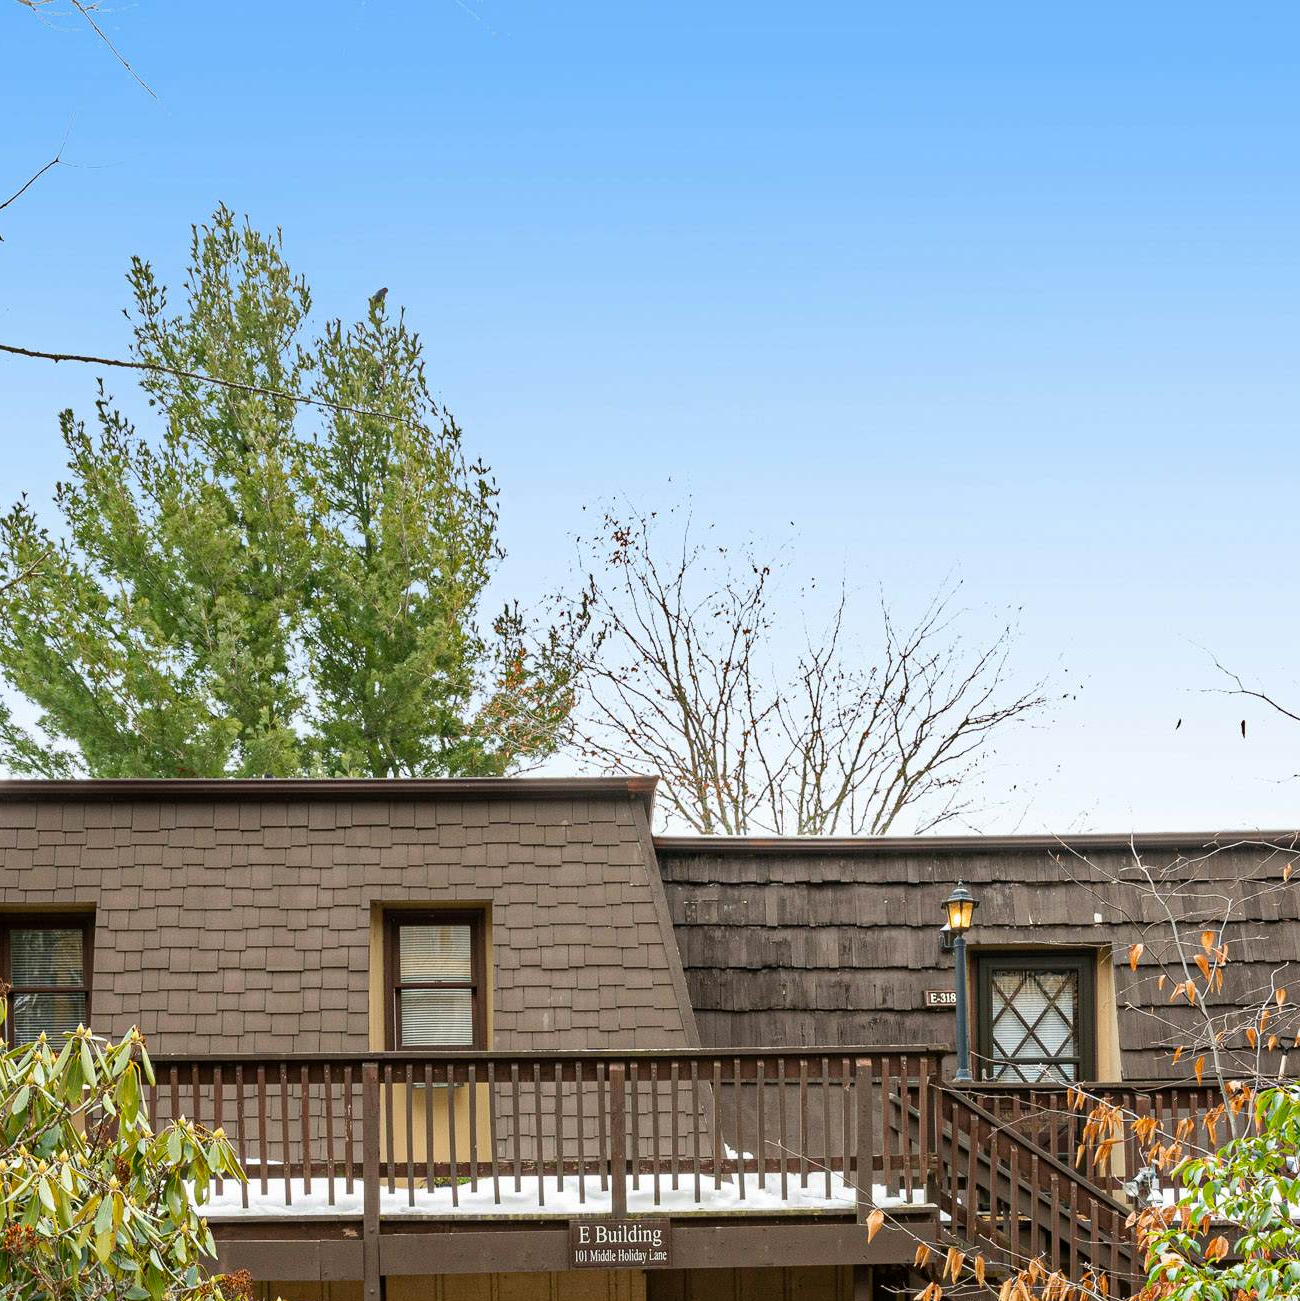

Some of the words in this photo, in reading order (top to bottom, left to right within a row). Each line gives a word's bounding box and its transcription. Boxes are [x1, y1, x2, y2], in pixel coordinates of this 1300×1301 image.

[930, 992, 957, 1003] E-318
[578, 1226, 591, 1244] E
[595, 1224, 662, 1247] Building
[575, 1250, 588, 1263] 101
[590, 1250, 617, 1262] Middle
[618, 1249, 647, 1264] Holiday
[649, 1248, 668, 1261] Lane
